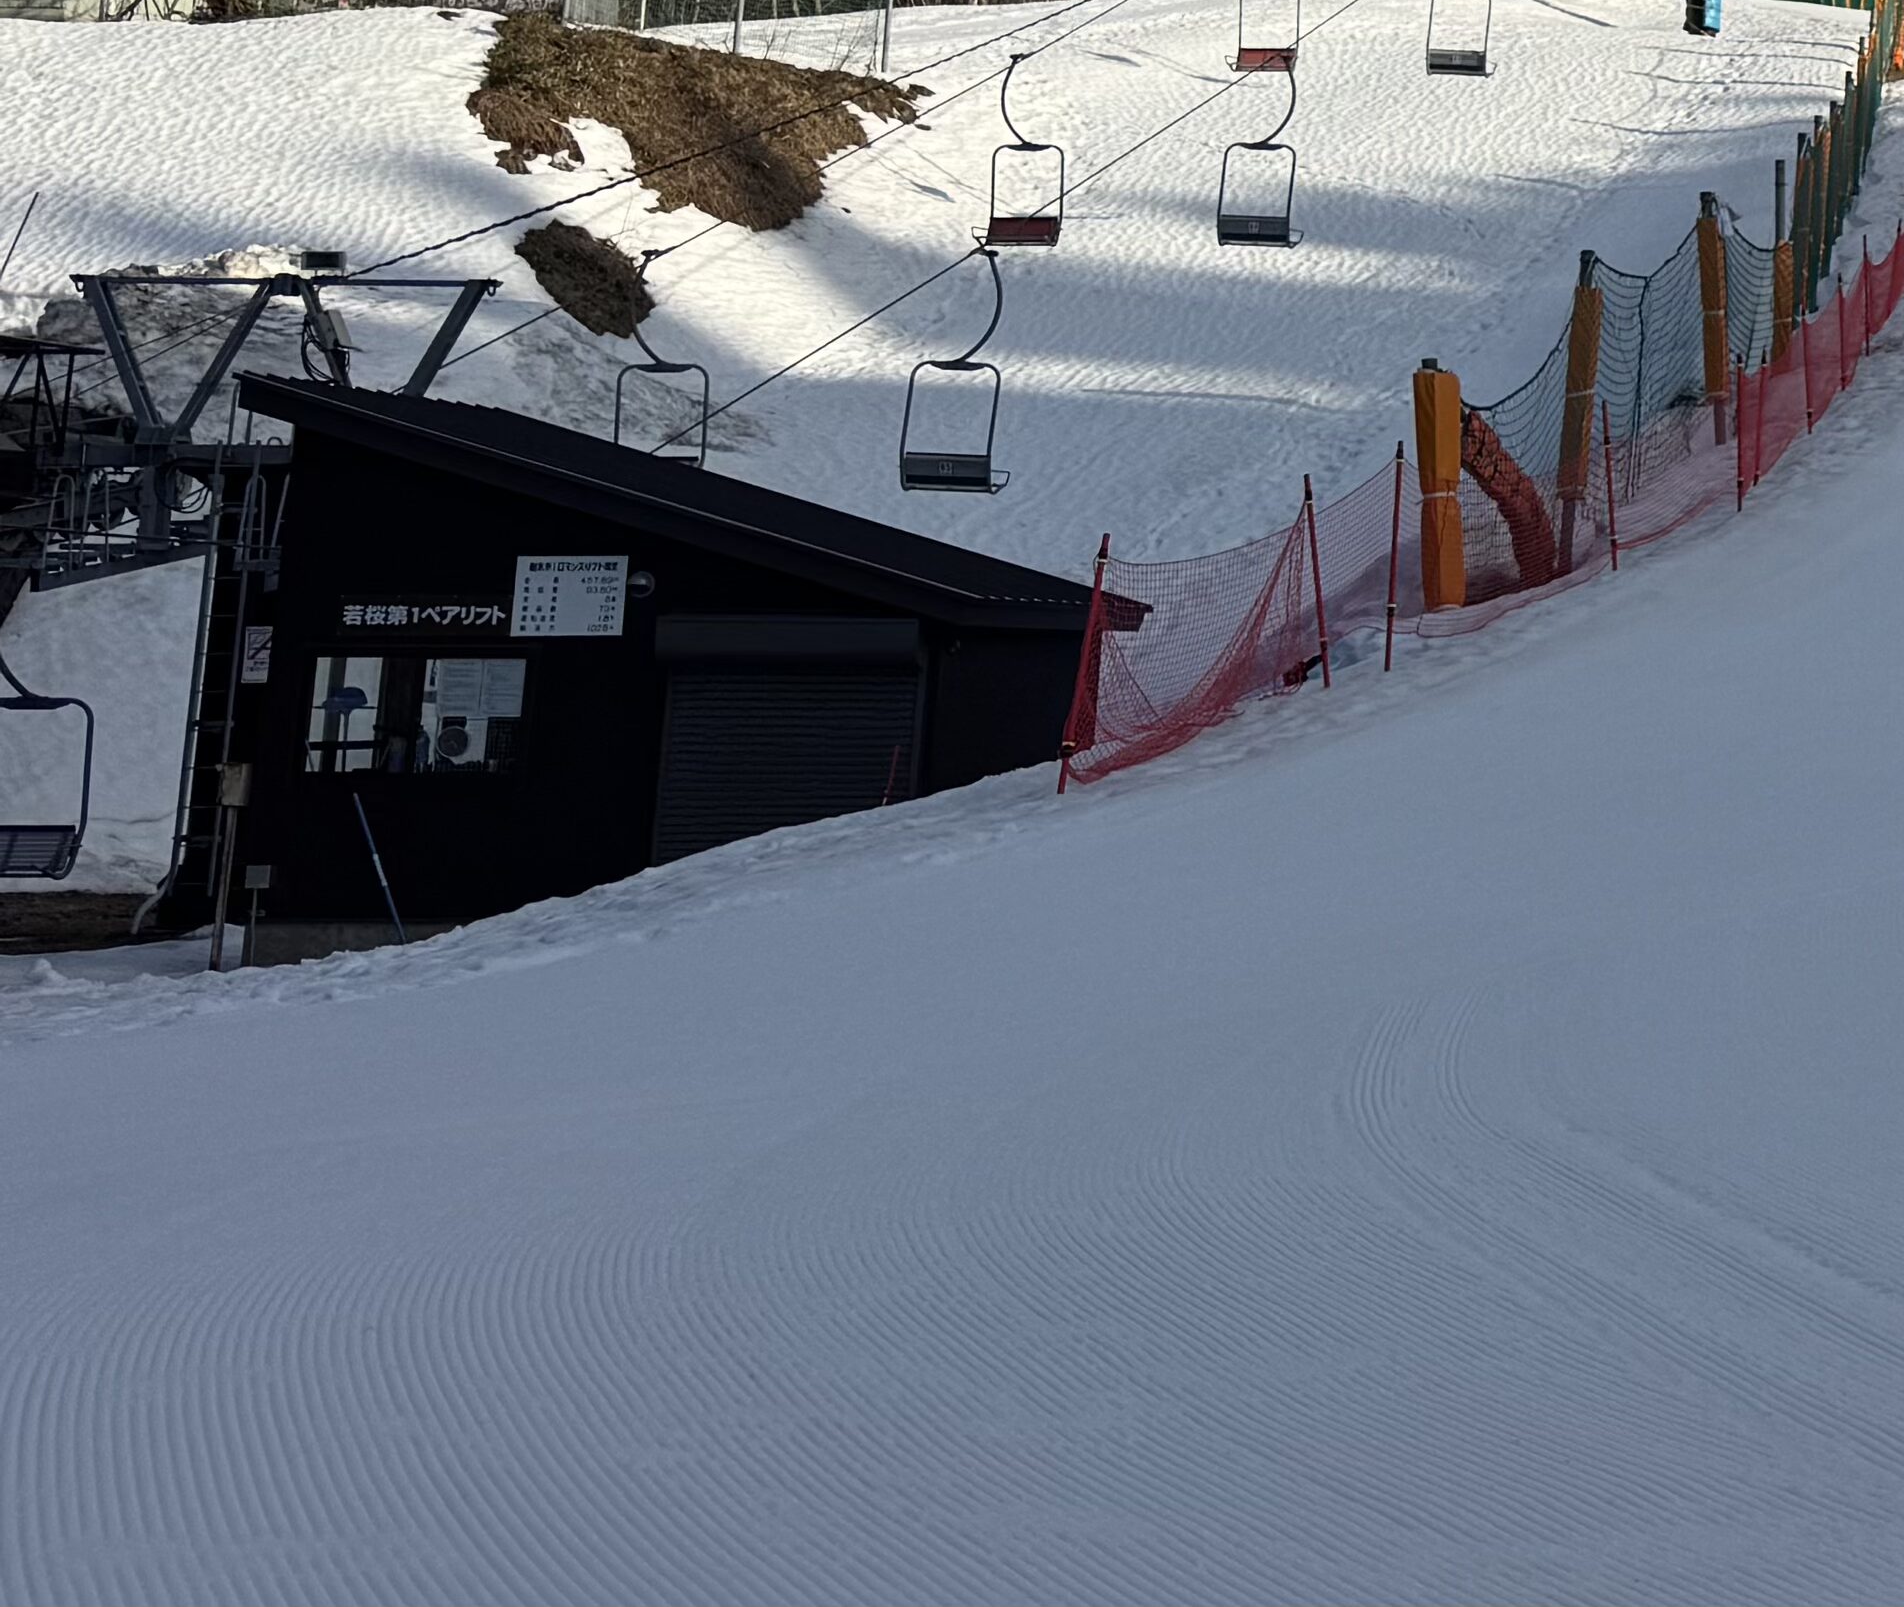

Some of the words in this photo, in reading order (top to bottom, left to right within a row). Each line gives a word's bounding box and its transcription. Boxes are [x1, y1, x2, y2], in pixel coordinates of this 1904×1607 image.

[342, 604, 506, 625] 若桜第1ペアリフト
